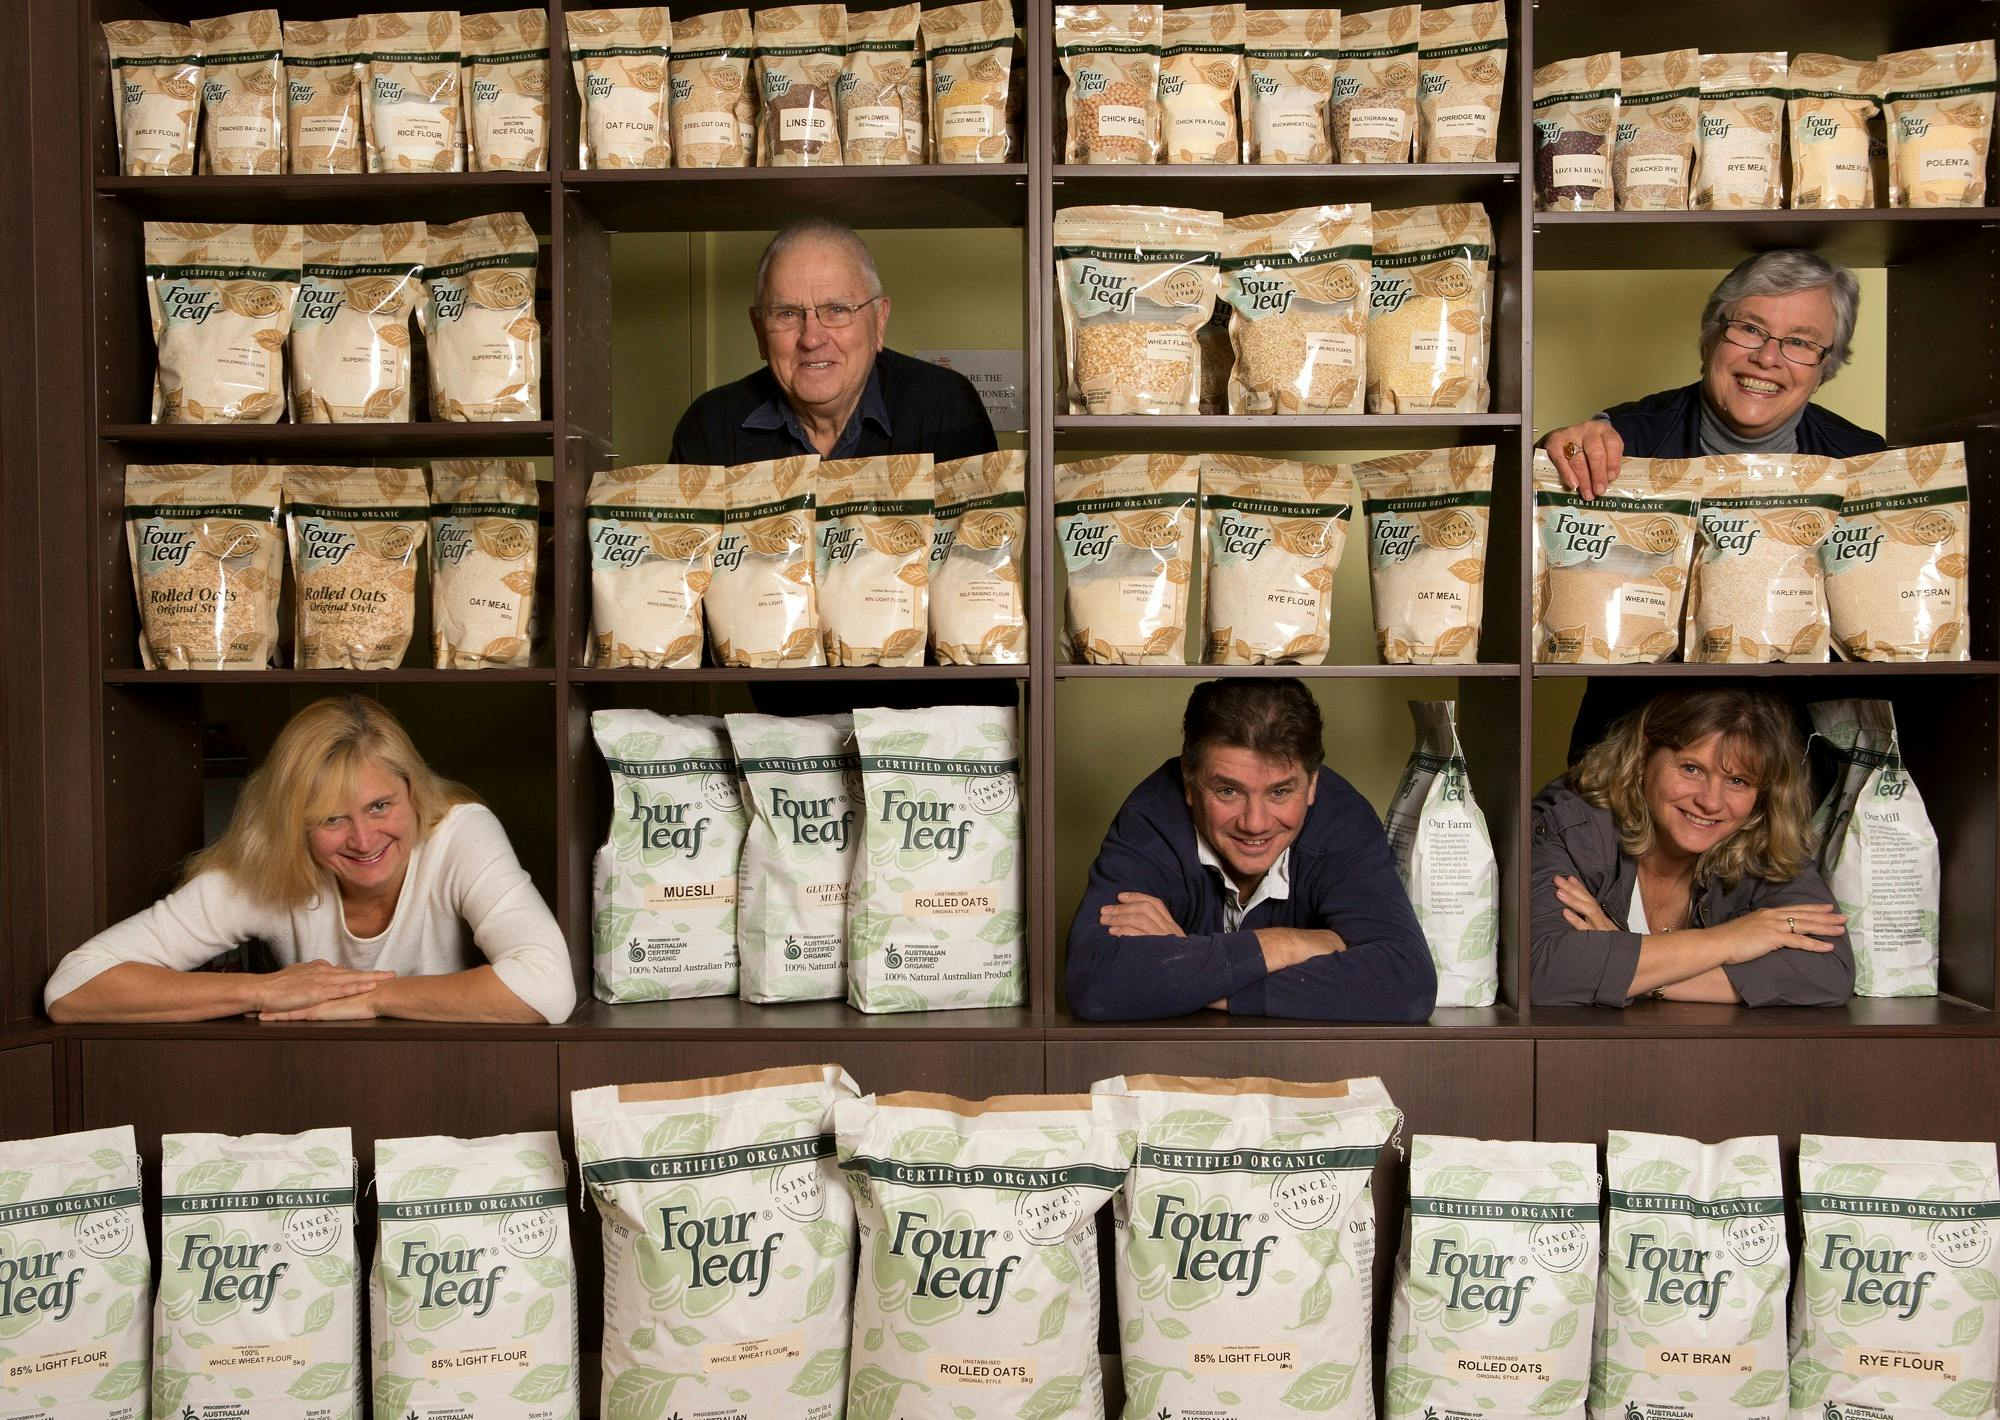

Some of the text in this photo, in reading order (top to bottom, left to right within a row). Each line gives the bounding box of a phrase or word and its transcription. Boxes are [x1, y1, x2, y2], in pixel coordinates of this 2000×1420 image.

[375, 78, 400, 92] Four
[379, 87, 405, 101] leaf
[786, 118, 826, 129] LINSEED
[1101, 115, 1145, 125] CHICK PEAS
[1175, 118, 1193, 126] CHICK
[1351, 115, 1398, 123] MULTIGRAIN MIX
[1437, 113, 1486, 123] PORRIDGE MIX
[135, 128, 180, 138] BARLEY FLOUR
[219, 125, 242, 133] CRACKED
[492, 127, 534, 136] RICE FLOUR
[605, 121, 654, 132] OAT FLOUR
[397, 130, 442, 139] RICE FLOUR
[1630, 165, 1662, 174] CRACKED
[1728, 163, 1767, 172] RYE MEAL
[1926, 159, 1969, 169] POLENTA
[1090, 250, 1185, 261] CERTIFIED ORGANIC
[180, 269, 268, 278] CERTIFIED ORGANIC
[1078, 265, 1129, 289] Four
[164, 287, 211, 304] Four
[1089, 283, 1138, 310] leaf
[175, 301, 219, 325] leaf
[1148, 338, 1171, 346] WHEAT
[155, 508, 243, 517] CERTIFIED ORGANIC
[610, 510, 696, 520] CERTIFIED ORGANIC
[1232, 501, 1321, 515] CERTIFIED ORGANIC
[1220, 516, 1264, 536] Four
[1555, 513, 1606, 535] Four
[1224, 535, 1271, 561] leaf
[1565, 534, 1617, 559] leaf
[305, 586, 387, 603] Rolled Oats
[1268, 595, 1315, 607] RYE FLOUR
[1418, 592, 1461, 601] OAT MEAL
[1625, 596, 1666, 606] WHEAT BRAN
[310, 601, 377, 615] Original Style
[469, 598, 512, 611] OAT MEAL
[877, 759, 1000, 773] CERTIFIED ORGANIC
[771, 787, 834, 819] Four
[880, 790, 955, 822] Four
[1429, 819, 1472, 829] Our Farm
[1864, 812, 1900, 822] Our Mill
[642, 818, 710, 858] leaf
[792, 811, 856, 852] leaf
[900, 819, 974, 860] leaf
[664, 884, 714, 898] MUESLI
[915, 897, 989, 908] ROLLED OATS
[884, 970, 1012, 981] 100% Natural Australian Product
[650, 1141, 821, 1176] CERTIFIED ORGANIC
[1153, 1151, 1326, 1168] CERTIFIED ORGANIC
[1281, 1179, 1328, 1201] SINCE
[181, 1193, 330, 1210] CERTIFIED ORGANIC
[1821, 1199, 1977, 1216] CERTIFIED ORGANIC
[1429, 1201, 1575, 1218] CERTIFIED ORGANIC
[1148, 1194, 1251, 1241] Four
[660, 1207, 757, 1252] Four
[889, 1211, 996, 1260] Four
[1937, 1226, 1979, 1243] SINCE
[177, 1234, 268, 1278] Four
[396, 1241, 486, 1281] Four
[1426, 1239, 1513, 1279] Four
[1626, 1234, 1710, 1274] Four
[1820, 1234, 1913, 1274] Four
[687, 1233, 784, 1297] leaf
[1172, 1235, 1278, 1297] leaf
[198, 1262, 289, 1313] leaf
[418, 1265, 506, 1318] leaf
[911, 1254, 1022, 1315] leaf
[1447, 1276, 1535, 1325] leaf
[1644, 1270, 1734, 1319] leaf
[1841, 1270, 1935, 1320] leaf
[10, 1350, 107, 1376] 85% LIGHT FLOUR
[209, 1355, 292, 1366] WHOLE WHEAT FLOUR
[293, 1359, 306, 1367] 5kg
[431, 1350, 527, 1369] 85% LIGHT FLOUR
[1194, 1351, 1291, 1364] 85% LIGHT FLOUR
[1660, 1352, 1731, 1364] OAT BRAN
[1859, 1354, 1945, 1371] RYE FLOUR
[940, 1364, 1026, 1377] ROLLED OATS
[1458, 1360, 1542, 1374] ROLLED OATS
[1537, 1373, 1549, 1381] 4kg
[1943, 1373, 1956, 1381] 5kg
